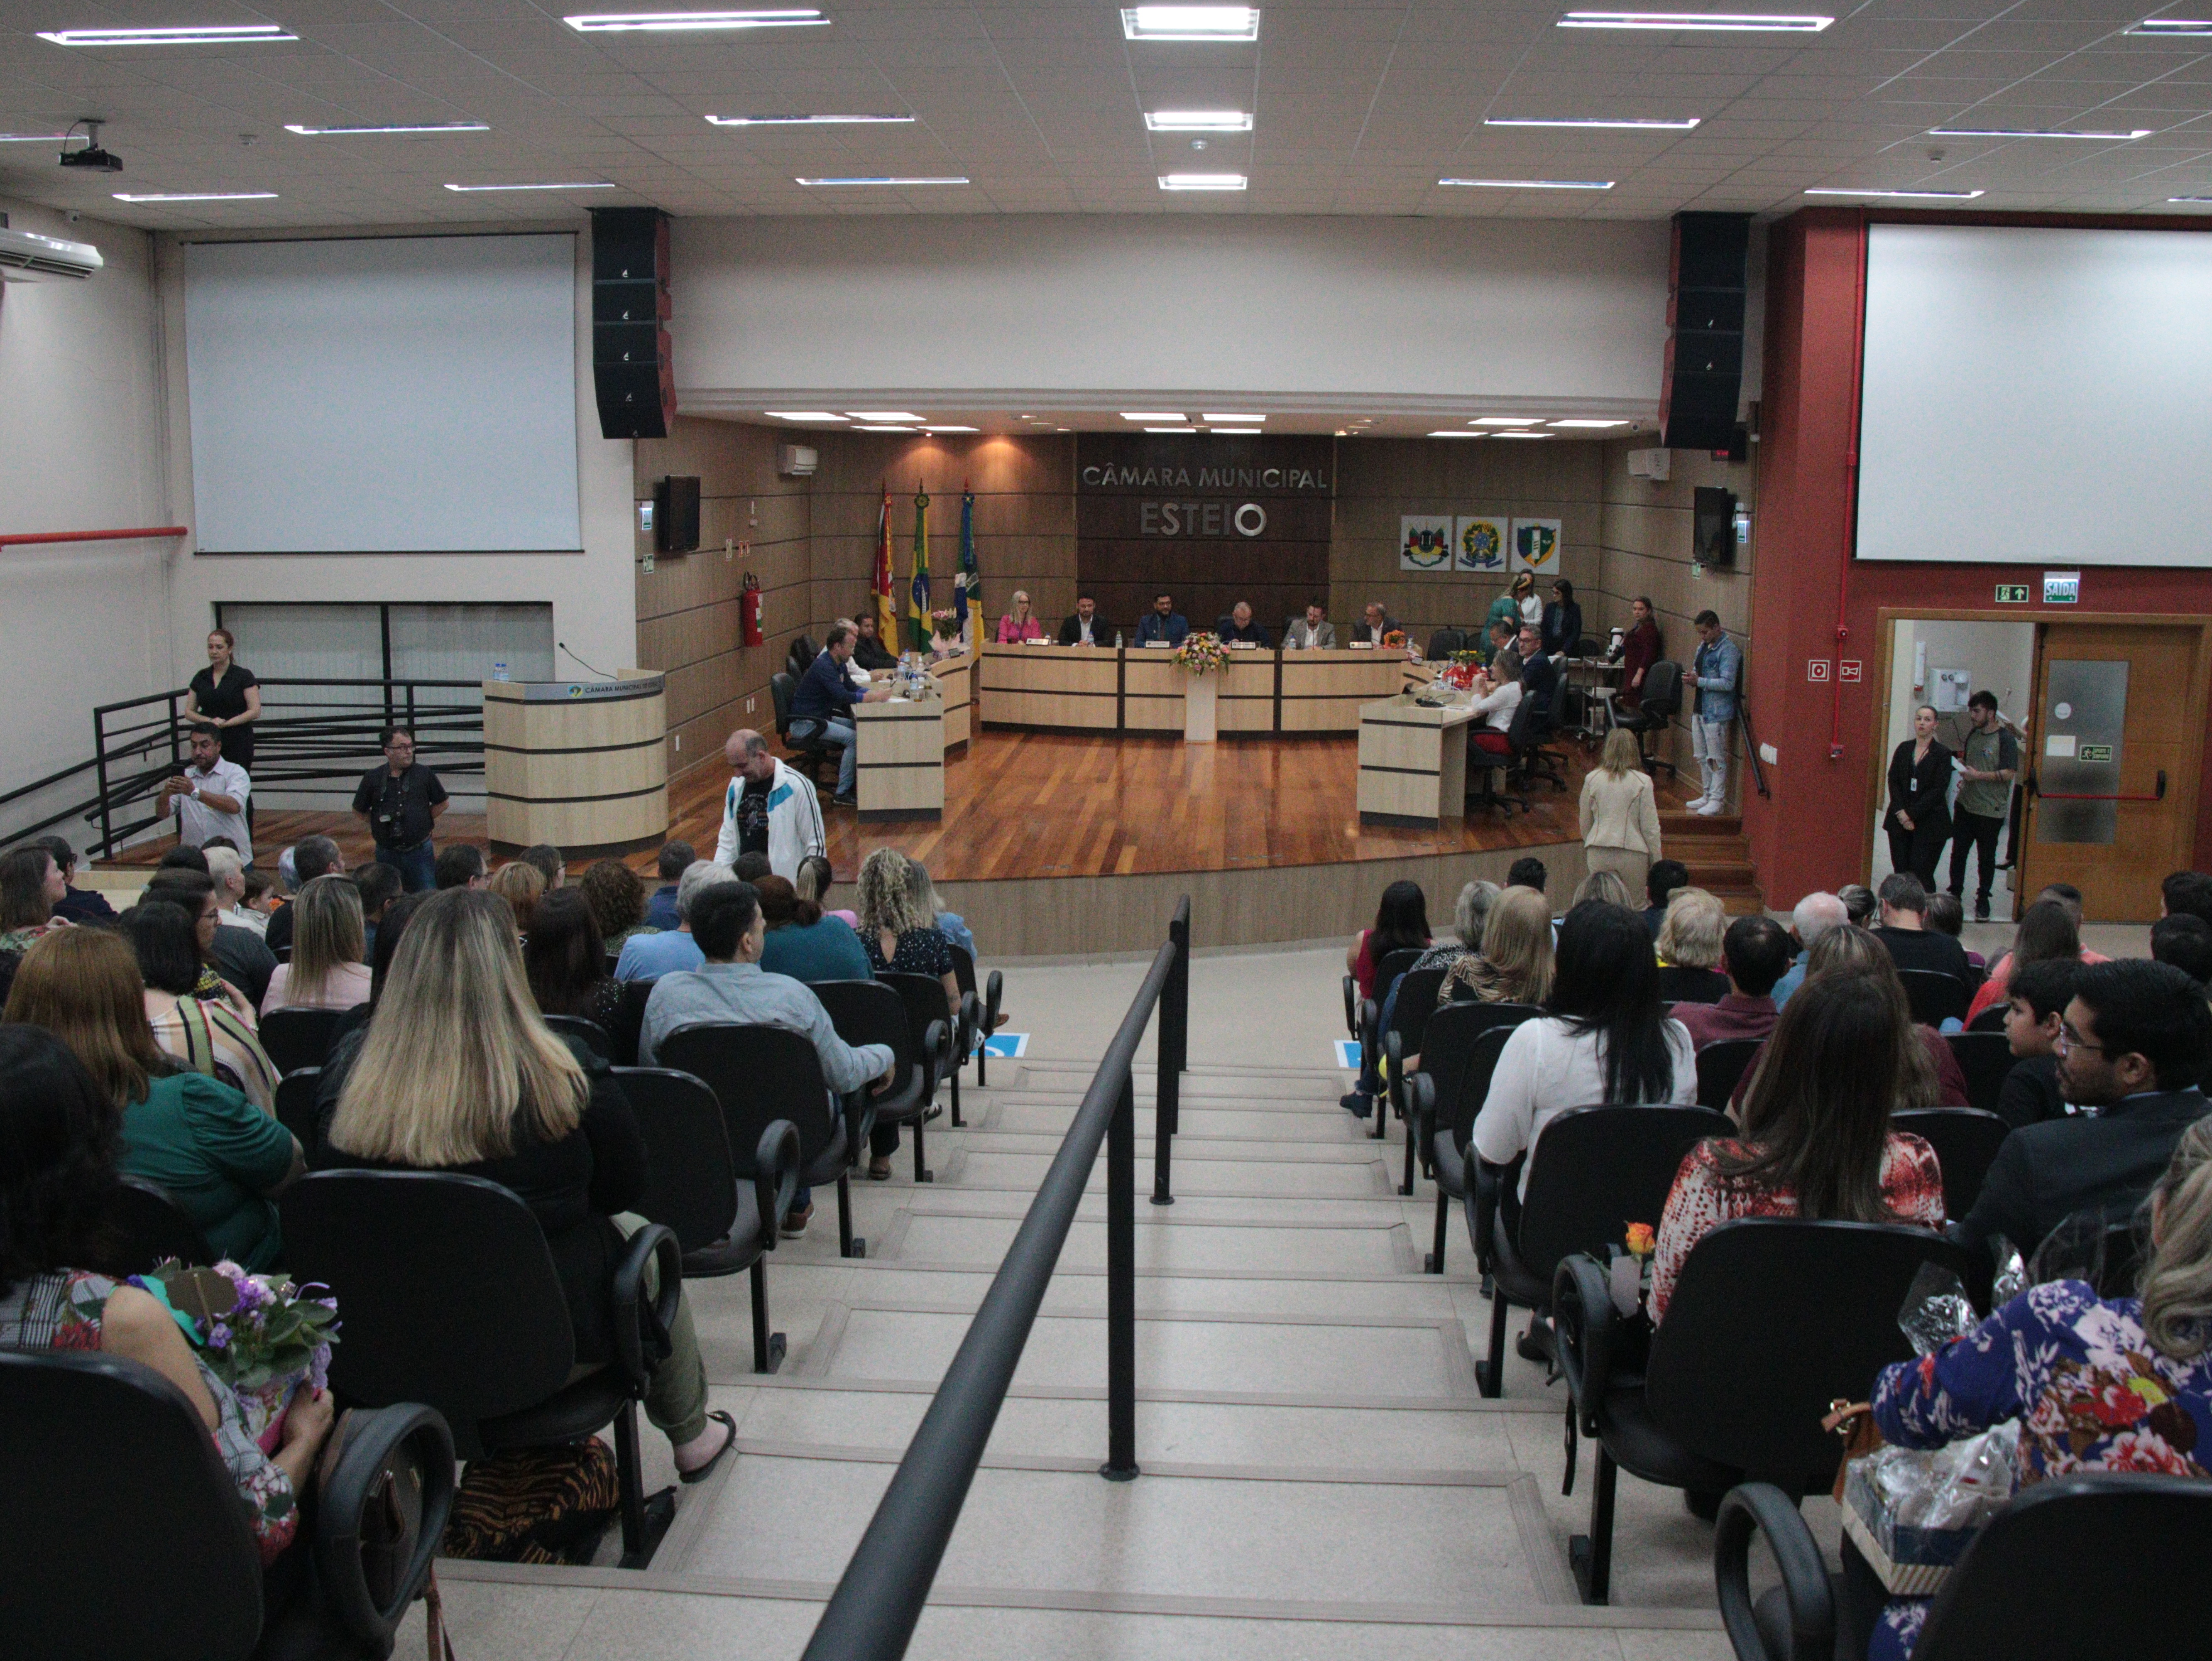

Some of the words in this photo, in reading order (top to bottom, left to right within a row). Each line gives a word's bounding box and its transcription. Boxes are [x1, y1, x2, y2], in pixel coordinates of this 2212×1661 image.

[1083, 462, 1191, 486] CÂMARA
[1199, 468, 1327, 488] MUNICIPAL
[1140, 502, 1267, 537] ESTEIO
